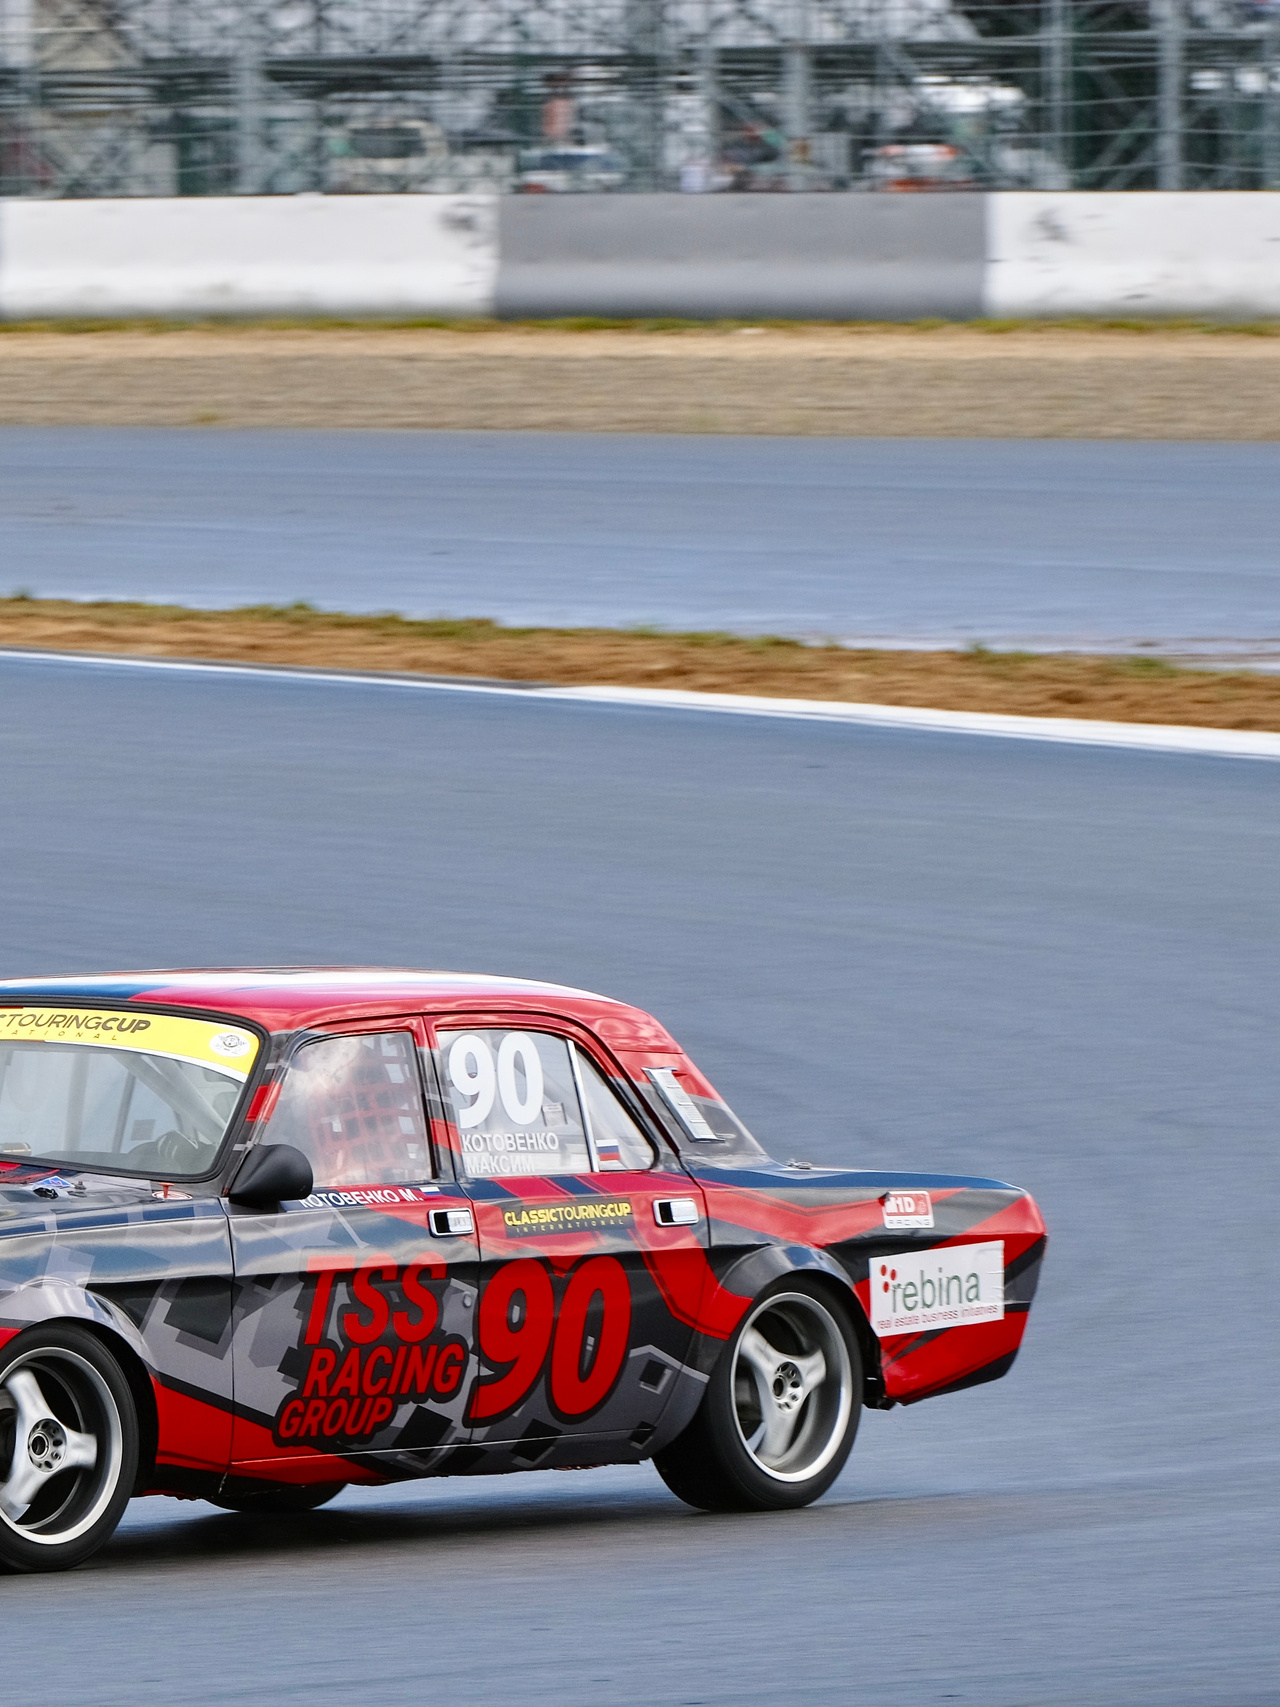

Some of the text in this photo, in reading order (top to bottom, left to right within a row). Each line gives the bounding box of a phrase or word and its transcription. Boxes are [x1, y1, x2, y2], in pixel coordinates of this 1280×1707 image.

[448, 1031, 545, 1130] 90
[461, 1131, 560, 1153] КОТОВЕНКО
[464, 1154, 536, 1175] МАКСИМ
[516, 1218, 625, 1233] INTERNATIONAL
[304, 1251, 448, 1345] TSS
[891, 1267, 980, 1313] rebina
[468, 1254, 632, 1420] 90
[894, 1314, 919, 1328] estate
[922, 1309, 959, 1324] business
[302, 1342, 467, 1398] RACING
[278, 1395, 394, 1439] GROUP
